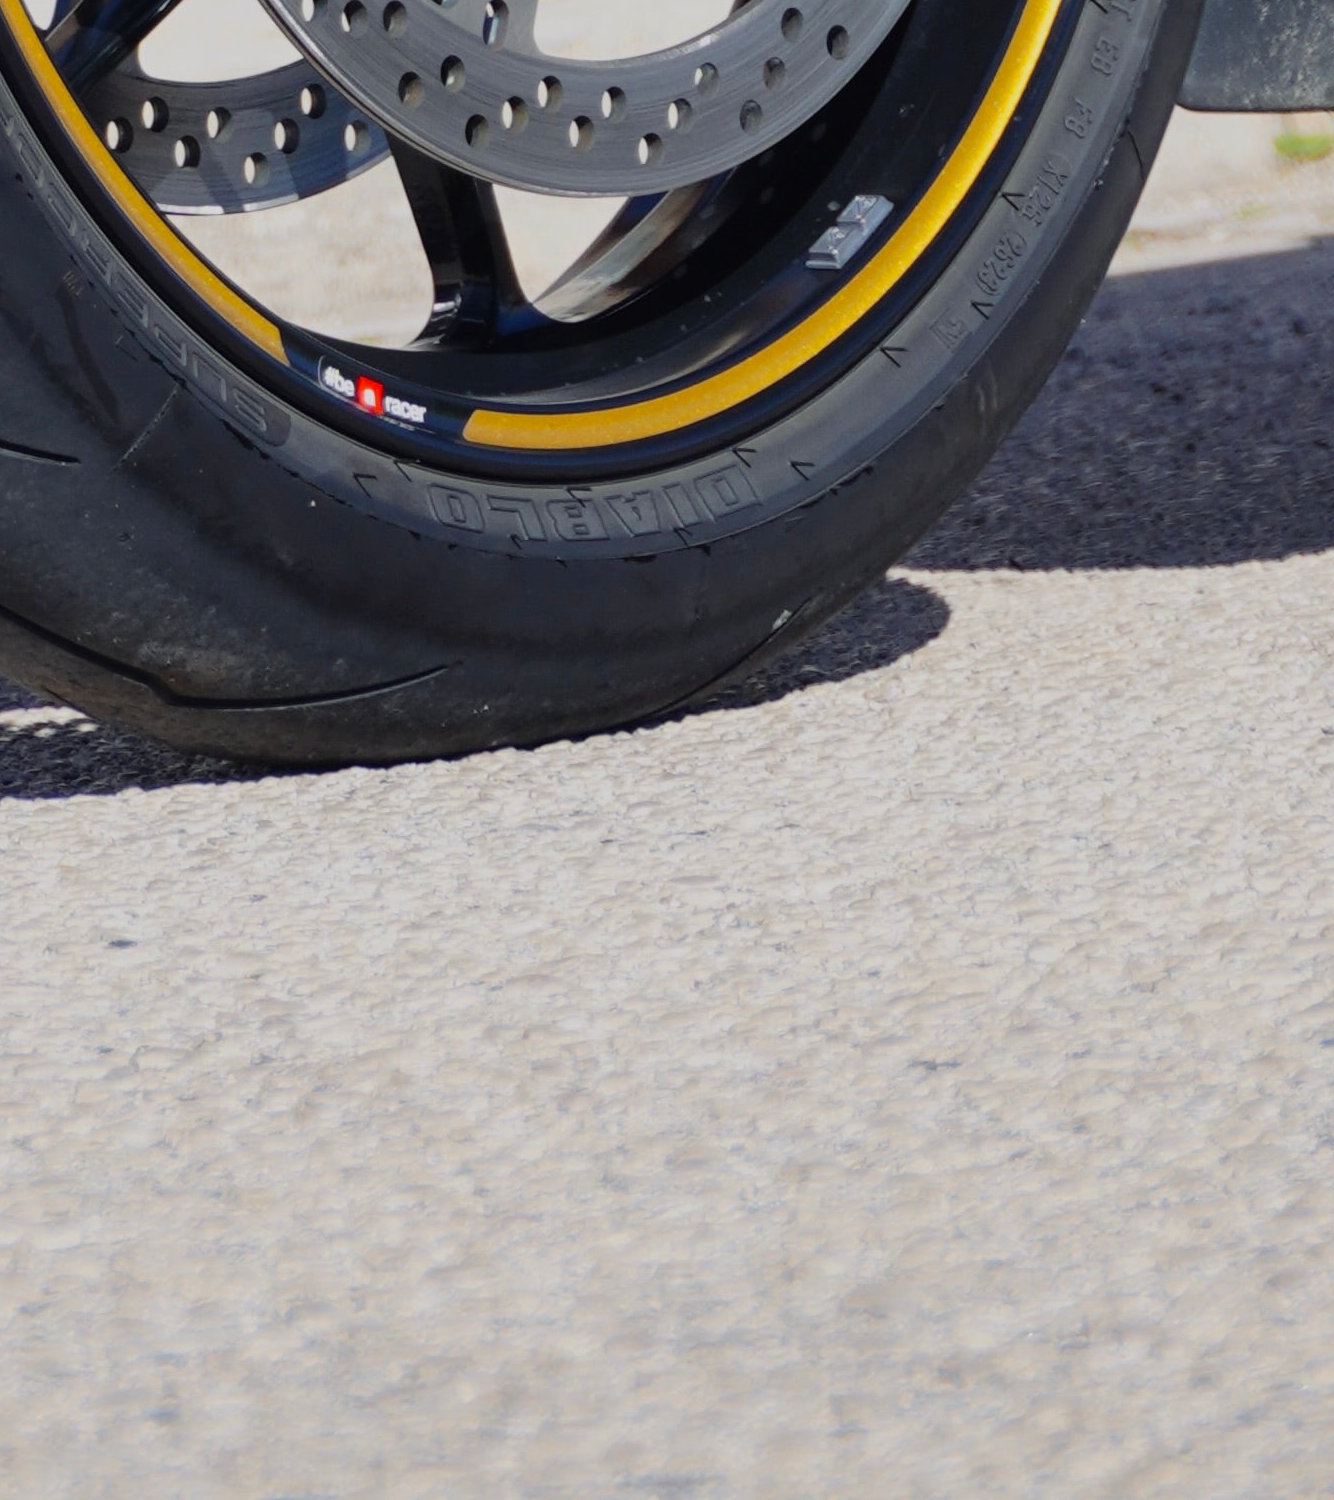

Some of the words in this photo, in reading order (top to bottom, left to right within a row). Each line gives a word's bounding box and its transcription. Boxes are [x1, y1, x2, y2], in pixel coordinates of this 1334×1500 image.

[323, 366, 355, 397] #be
[384, 396, 427, 424] racer
[426, 464, 764, 542] DIABLO
